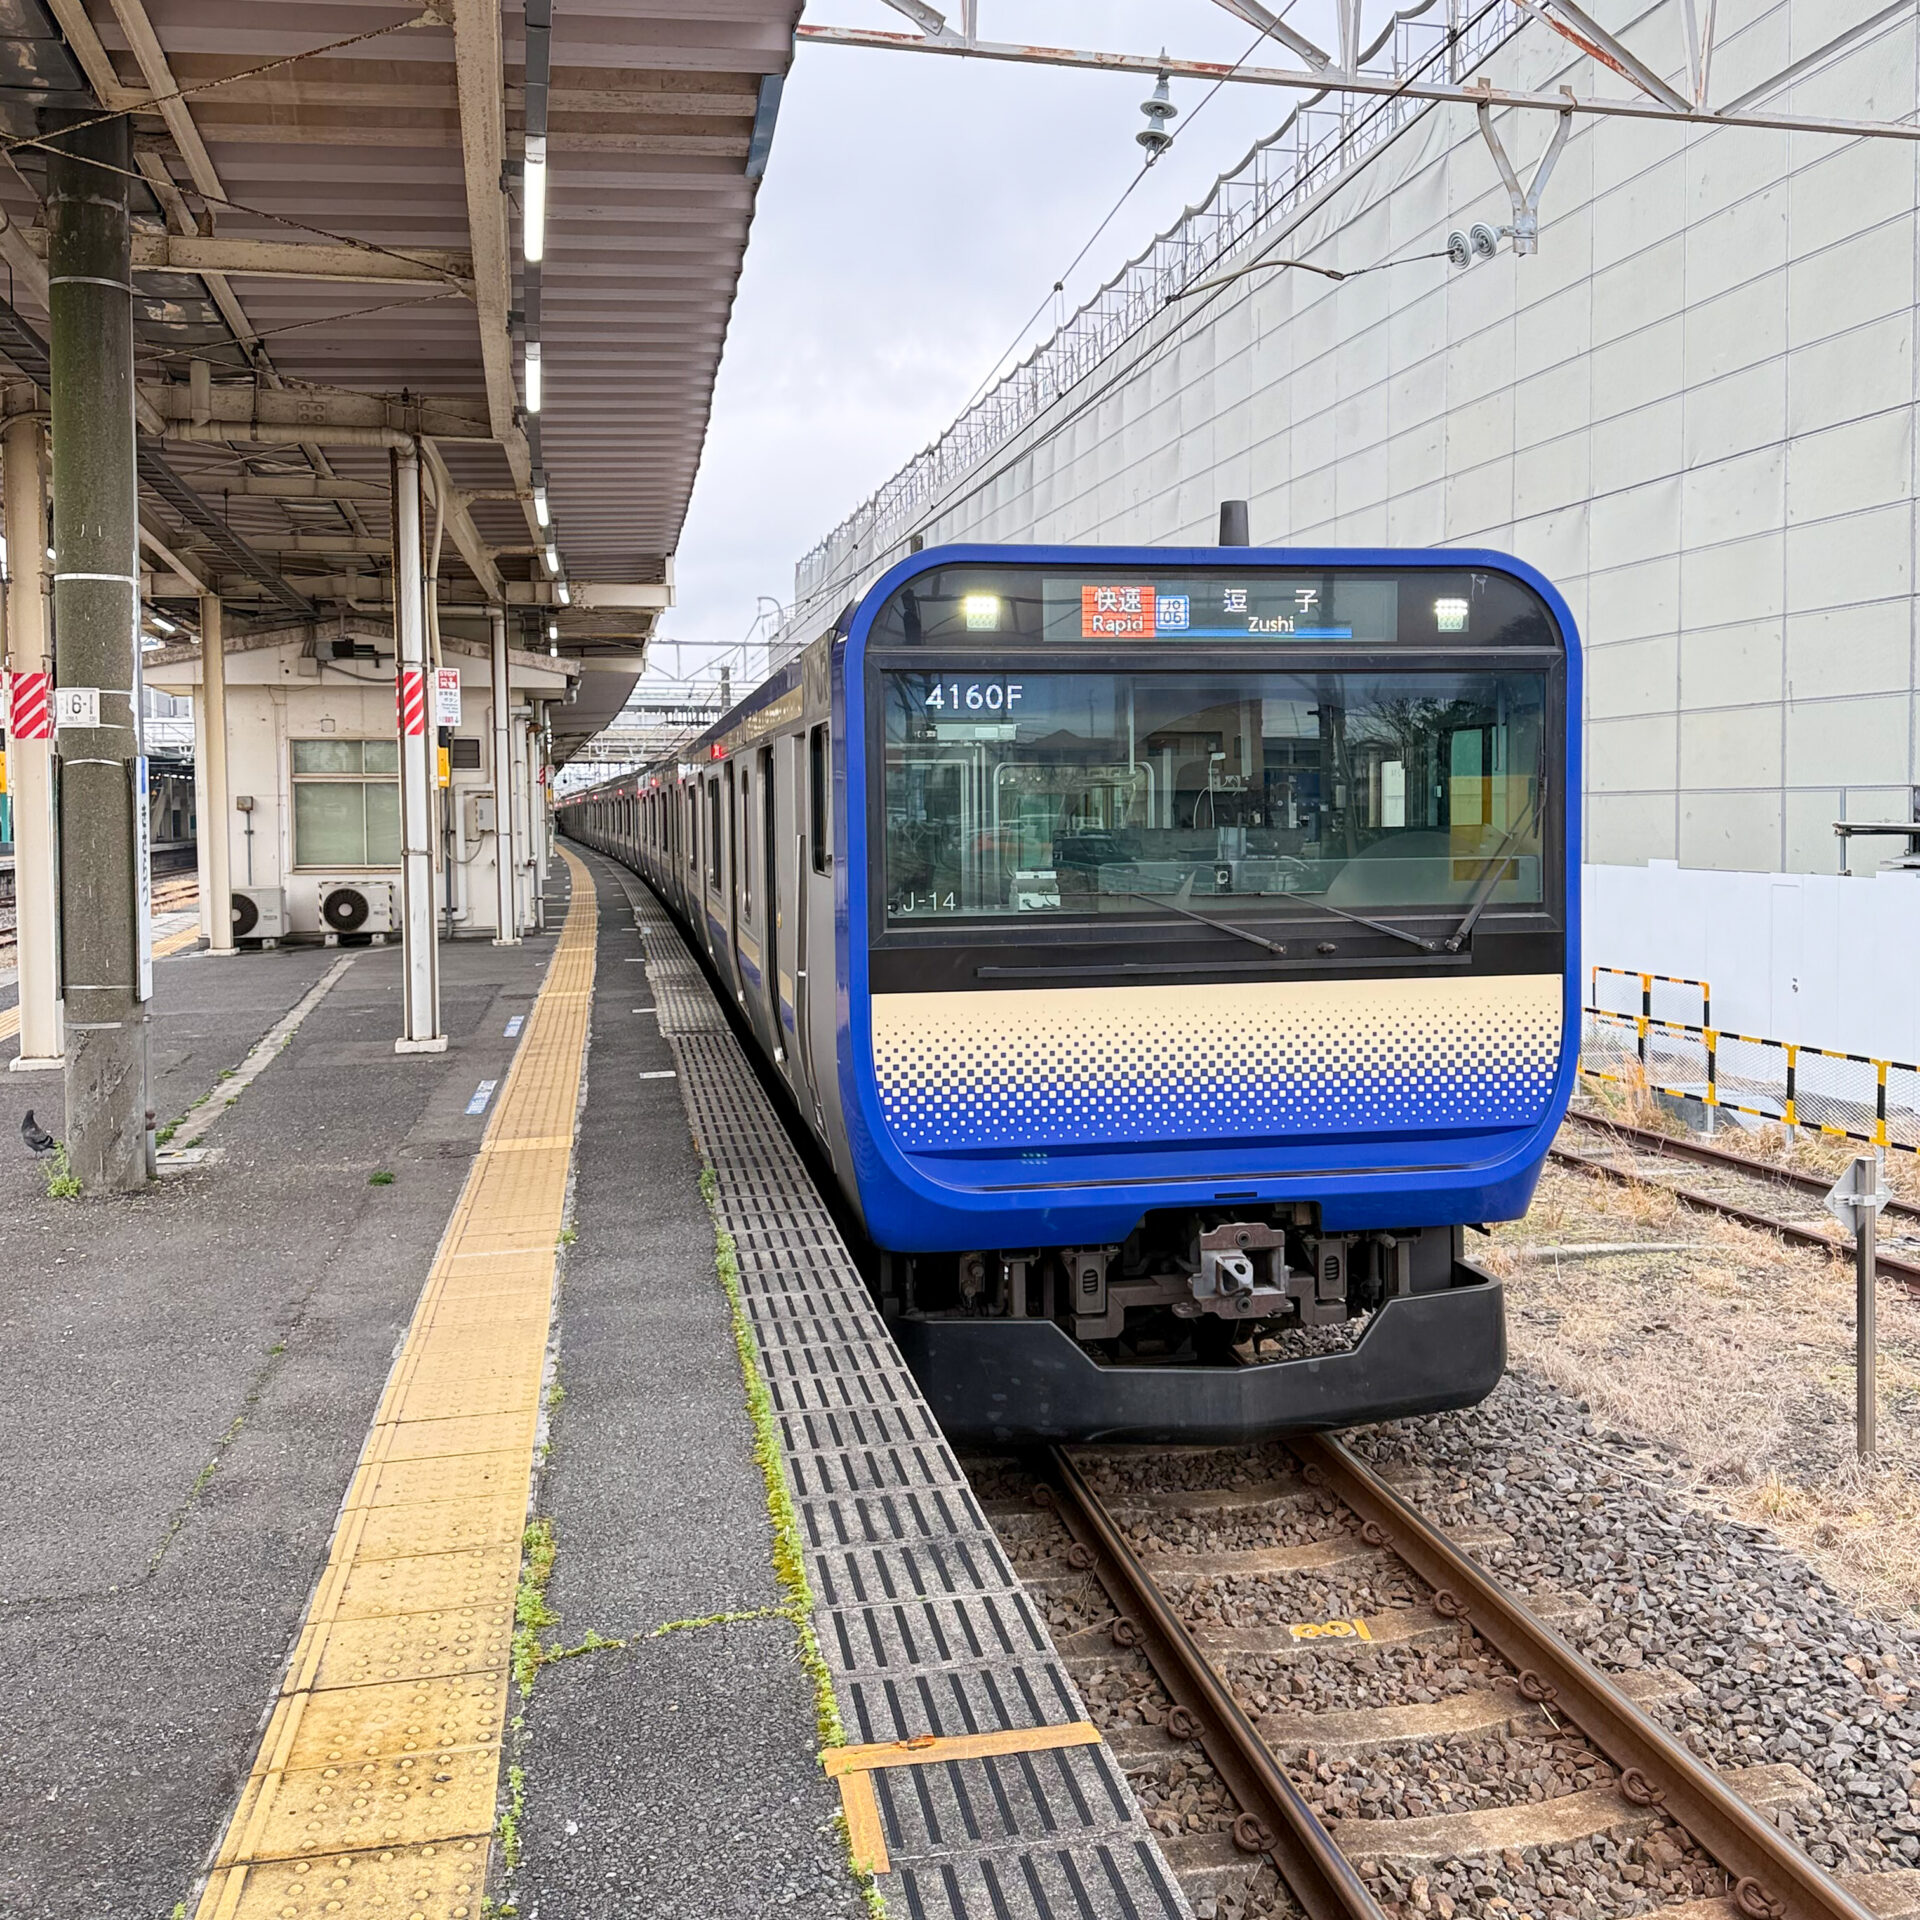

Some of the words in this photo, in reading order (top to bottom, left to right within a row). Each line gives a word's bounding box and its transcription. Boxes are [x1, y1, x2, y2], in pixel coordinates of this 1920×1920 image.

[1094, 587, 1142, 613] 快速
[1166, 600, 1181, 611] JO
[1092, 615, 1143, 635] Rapid
[1163, 611, 1181, 624] 06
[1248, 616, 1295, 633] Zushi
[925, 683, 1023, 710] 4160F
[903, 892, 956, 912] J-14
